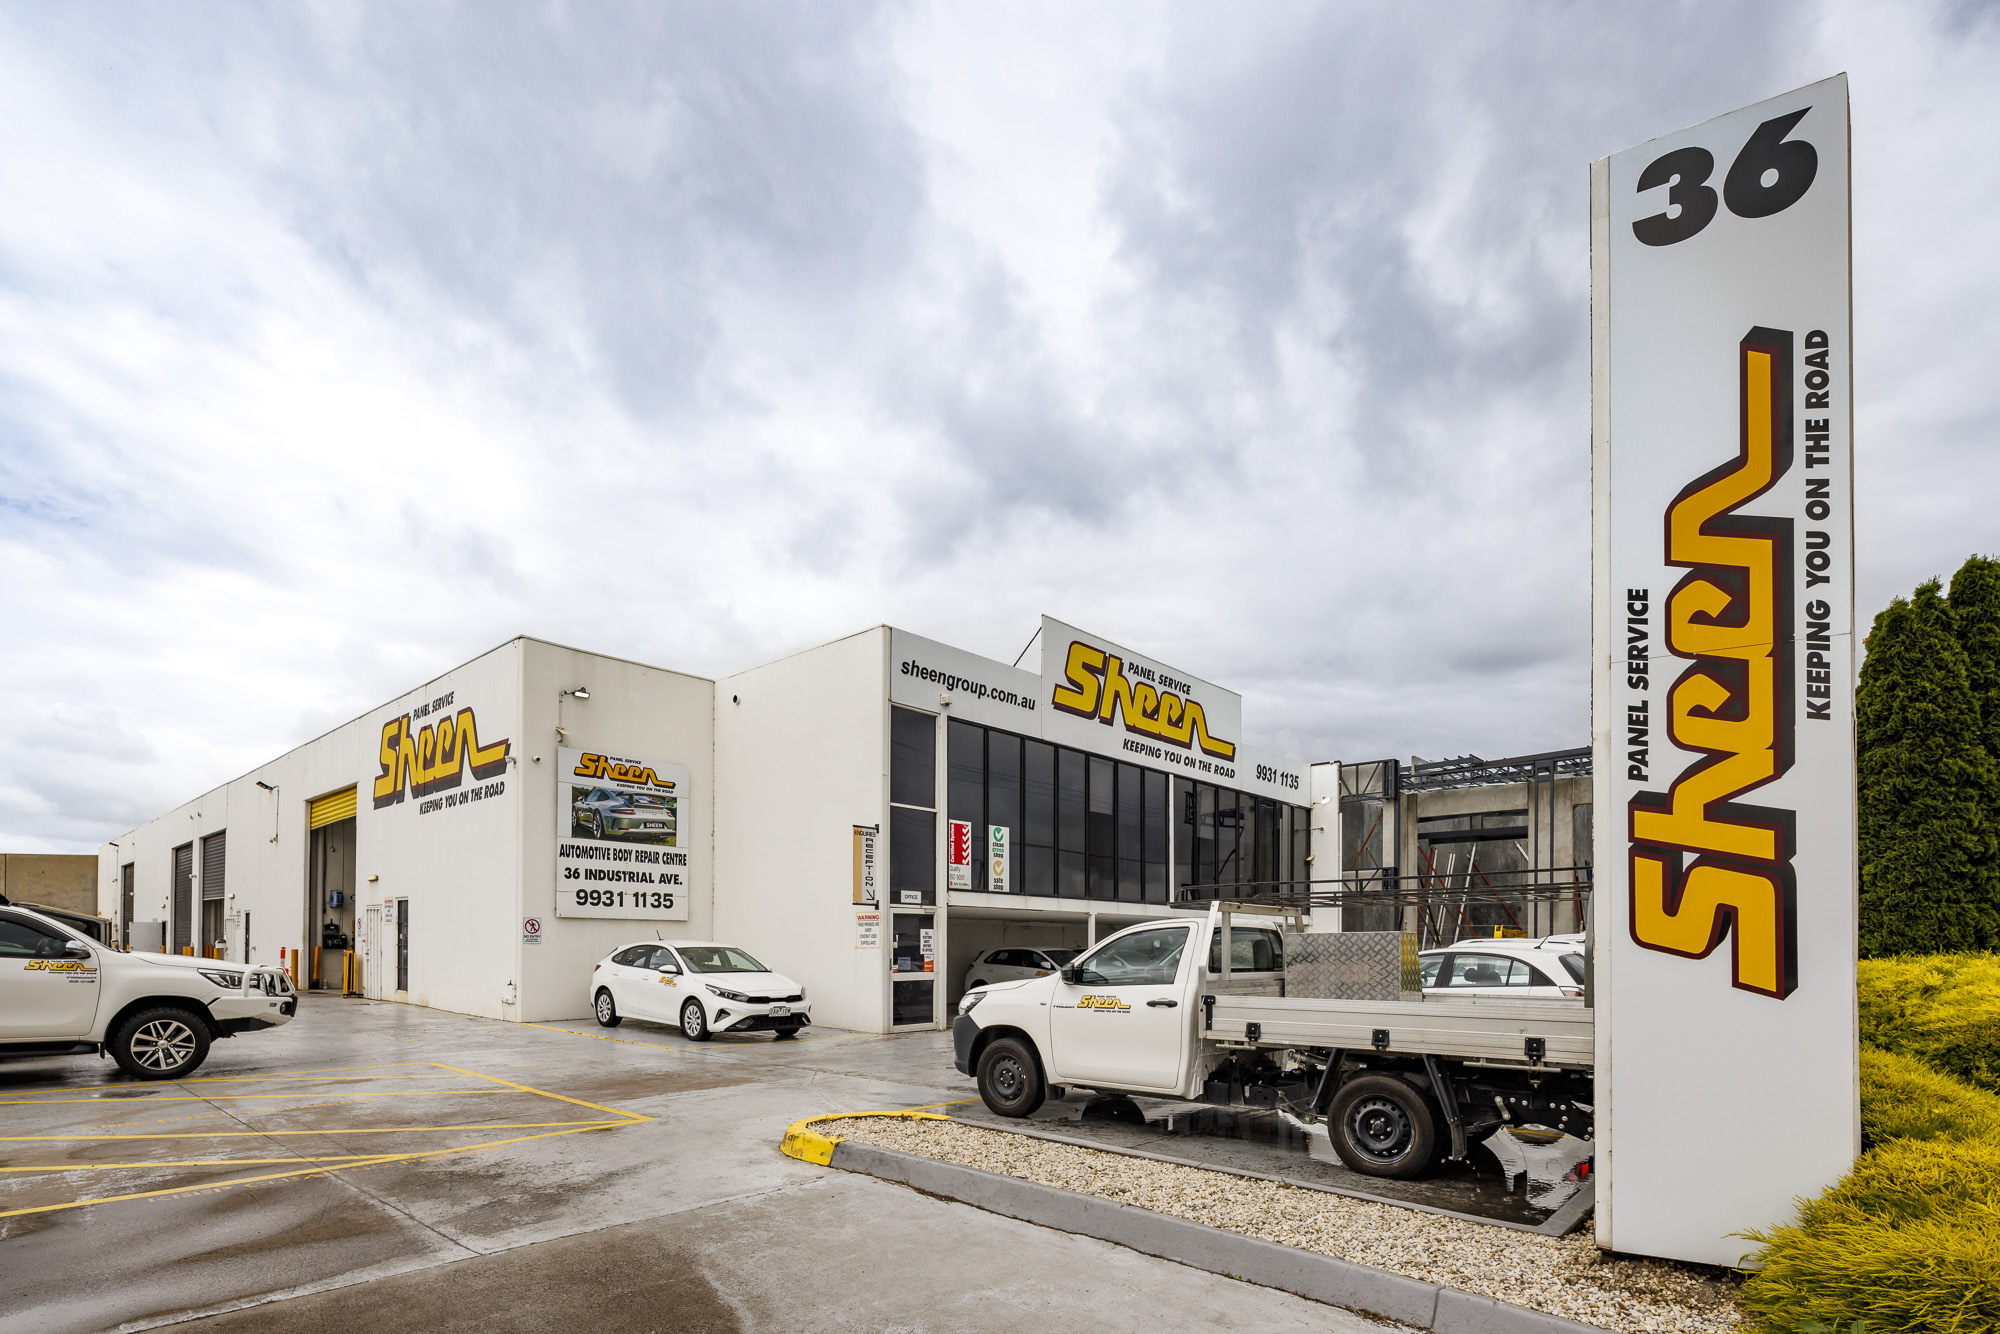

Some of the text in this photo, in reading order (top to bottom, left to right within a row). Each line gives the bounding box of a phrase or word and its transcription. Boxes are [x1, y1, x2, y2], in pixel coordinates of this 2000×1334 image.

[1631, 105, 1819, 247] 36
[1805, 329, 1831, 721] KEEPING YOU ON THE ROAD
[1128, 661, 1192, 696] PANEL SERVICE
[1627, 325, 1799, 1001] Sheen
[900, 659, 1036, 711] sheengroup.com.au
[1051, 640, 1236, 763] Sheen
[1627, 588, 1649, 782] PANEL SERVICE
[412, 690, 455, 721] PANEL SERVICE
[373, 706, 512, 810] Sheen
[574, 752, 676, 789] Sheen
[1122, 738, 1236, 779] KEEPING YOU ON THE ROAD
[1256, 763, 1299, 791] 9931 1135
[419, 781, 505, 815] KEEPING YOU ON THE ROAD
[853, 830, 877, 838] ENQUIRIES
[559, 844, 687, 866] AUTOMOTIVE BODY REPAIR CENTRE
[865, 837, 874, 887] RECEPTION
[564, 867, 683, 885] 36 INDUSTRIAL AVE.
[575, 889, 674, 909] 9931 1135
[24, 960, 98, 971] Sheen
[1077, 995, 1131, 1009] Sheen
